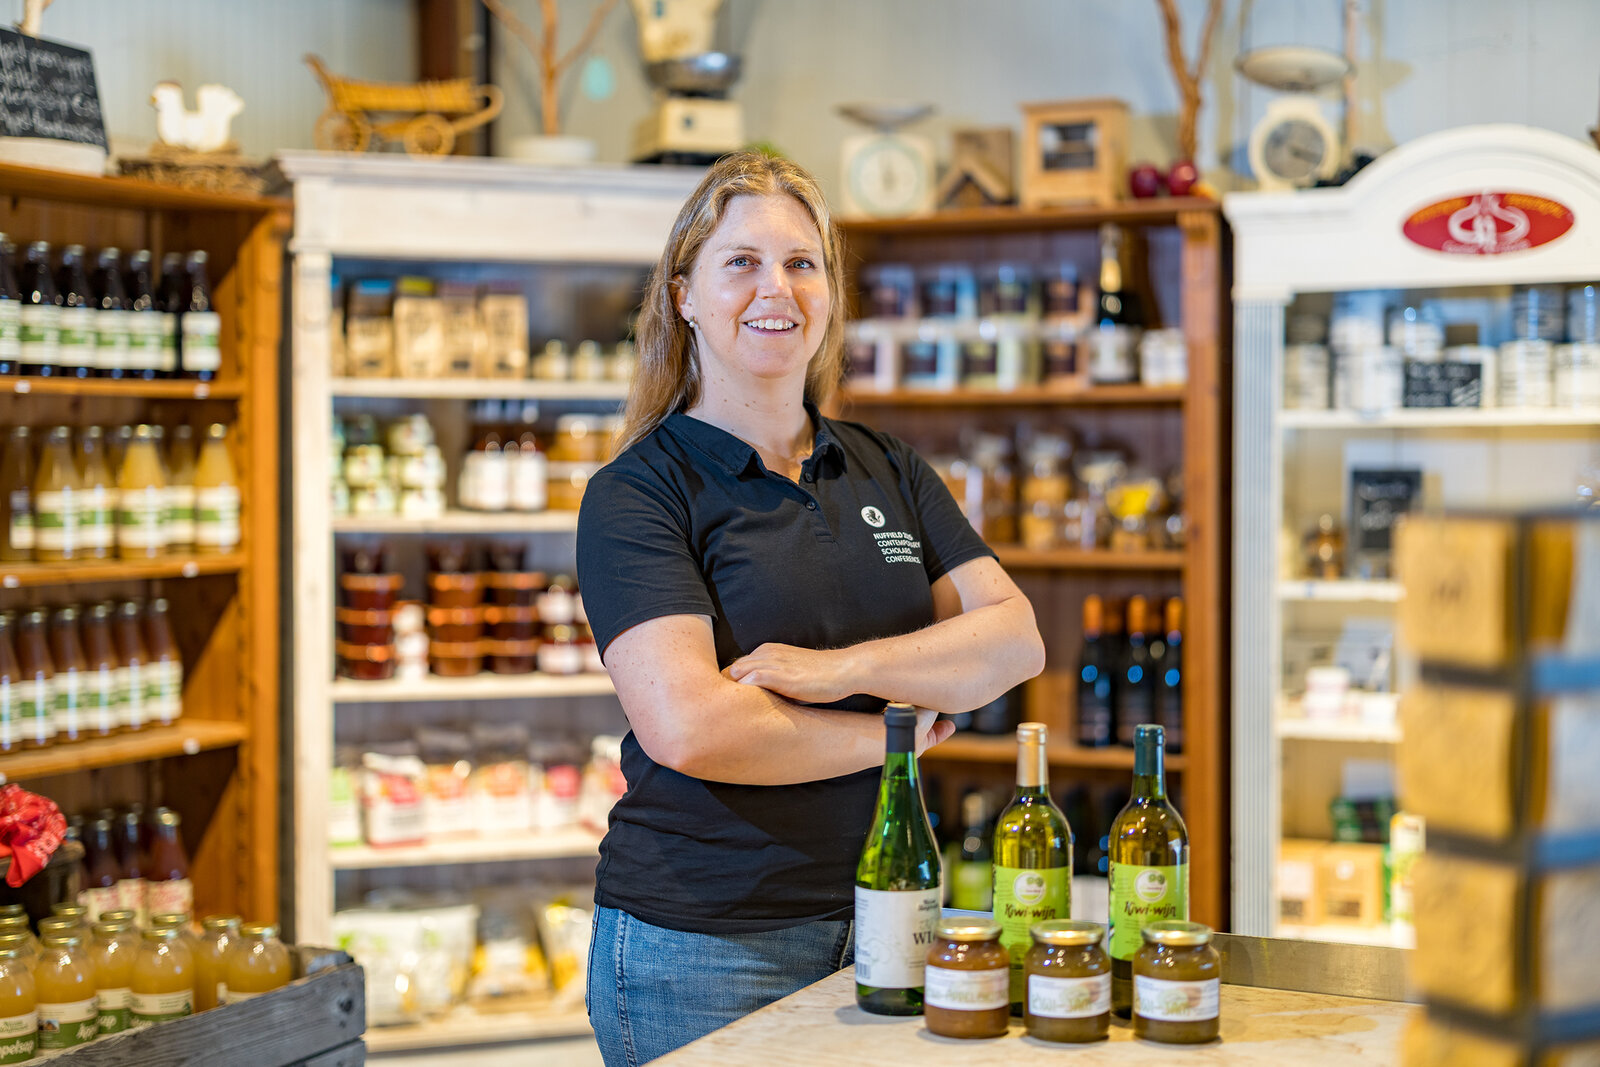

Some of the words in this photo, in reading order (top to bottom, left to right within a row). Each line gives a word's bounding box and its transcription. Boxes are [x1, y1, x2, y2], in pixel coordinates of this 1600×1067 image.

[873, 531, 903, 539] NUFFIELD
[877, 540, 921, 548] CONTEMPORARY
[881, 547, 912, 555] SCHOLARS
[885, 555, 921, 564] CONFERENCE
[1005, 903, 1056, 920] Kiwi-wijn
[1124, 901, 1176, 918] Kiwi-wijn
